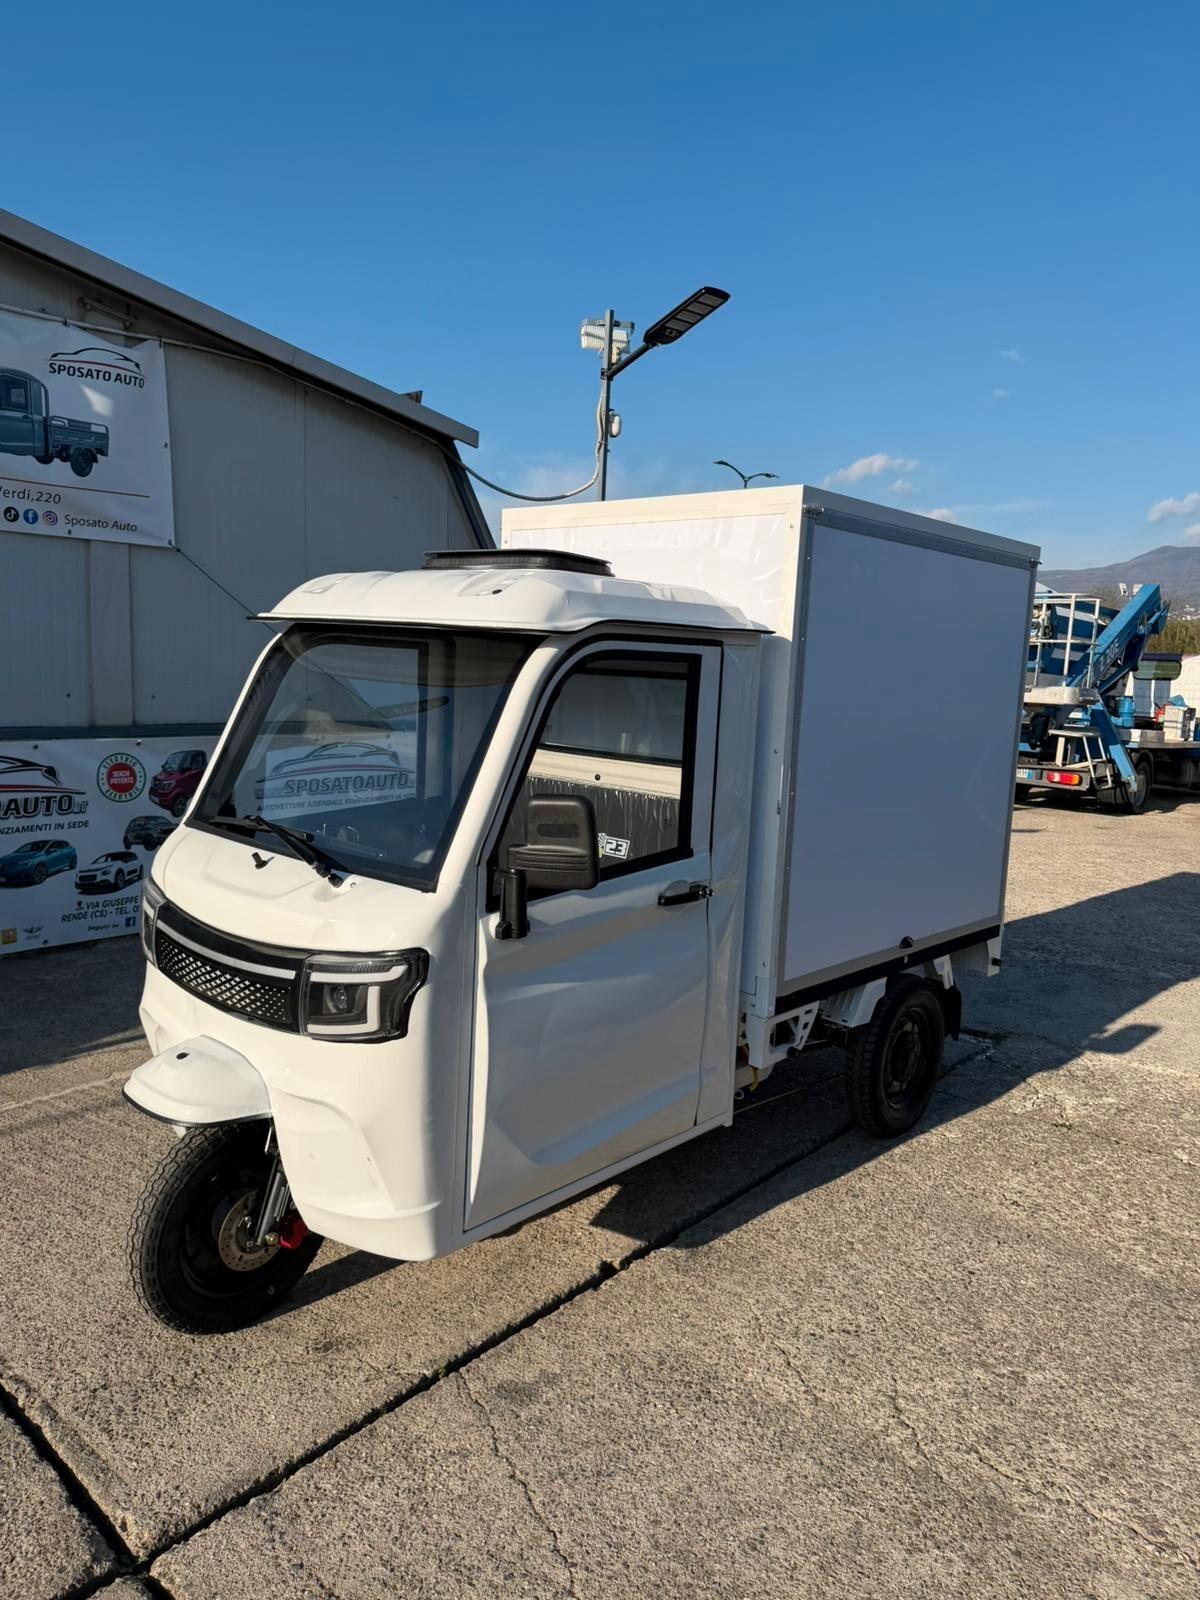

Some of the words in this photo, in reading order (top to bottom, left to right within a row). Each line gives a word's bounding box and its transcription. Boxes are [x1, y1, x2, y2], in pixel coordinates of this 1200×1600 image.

[49, 363, 111, 381] SPOSATO
[114, 373, 145, 389] AUTO
[64, 514, 109, 528] Sposato
[111, 522, 138, 532] Auto
[54, 822, 65, 831] IN
[67, 820, 90, 829] SEDE
[605, 839, 627, 856] 23
[102, 896, 139, 908] GIUSEPPE
[61, 911, 88, 923] RENDE
[90, 909, 108, 920] (CS)
